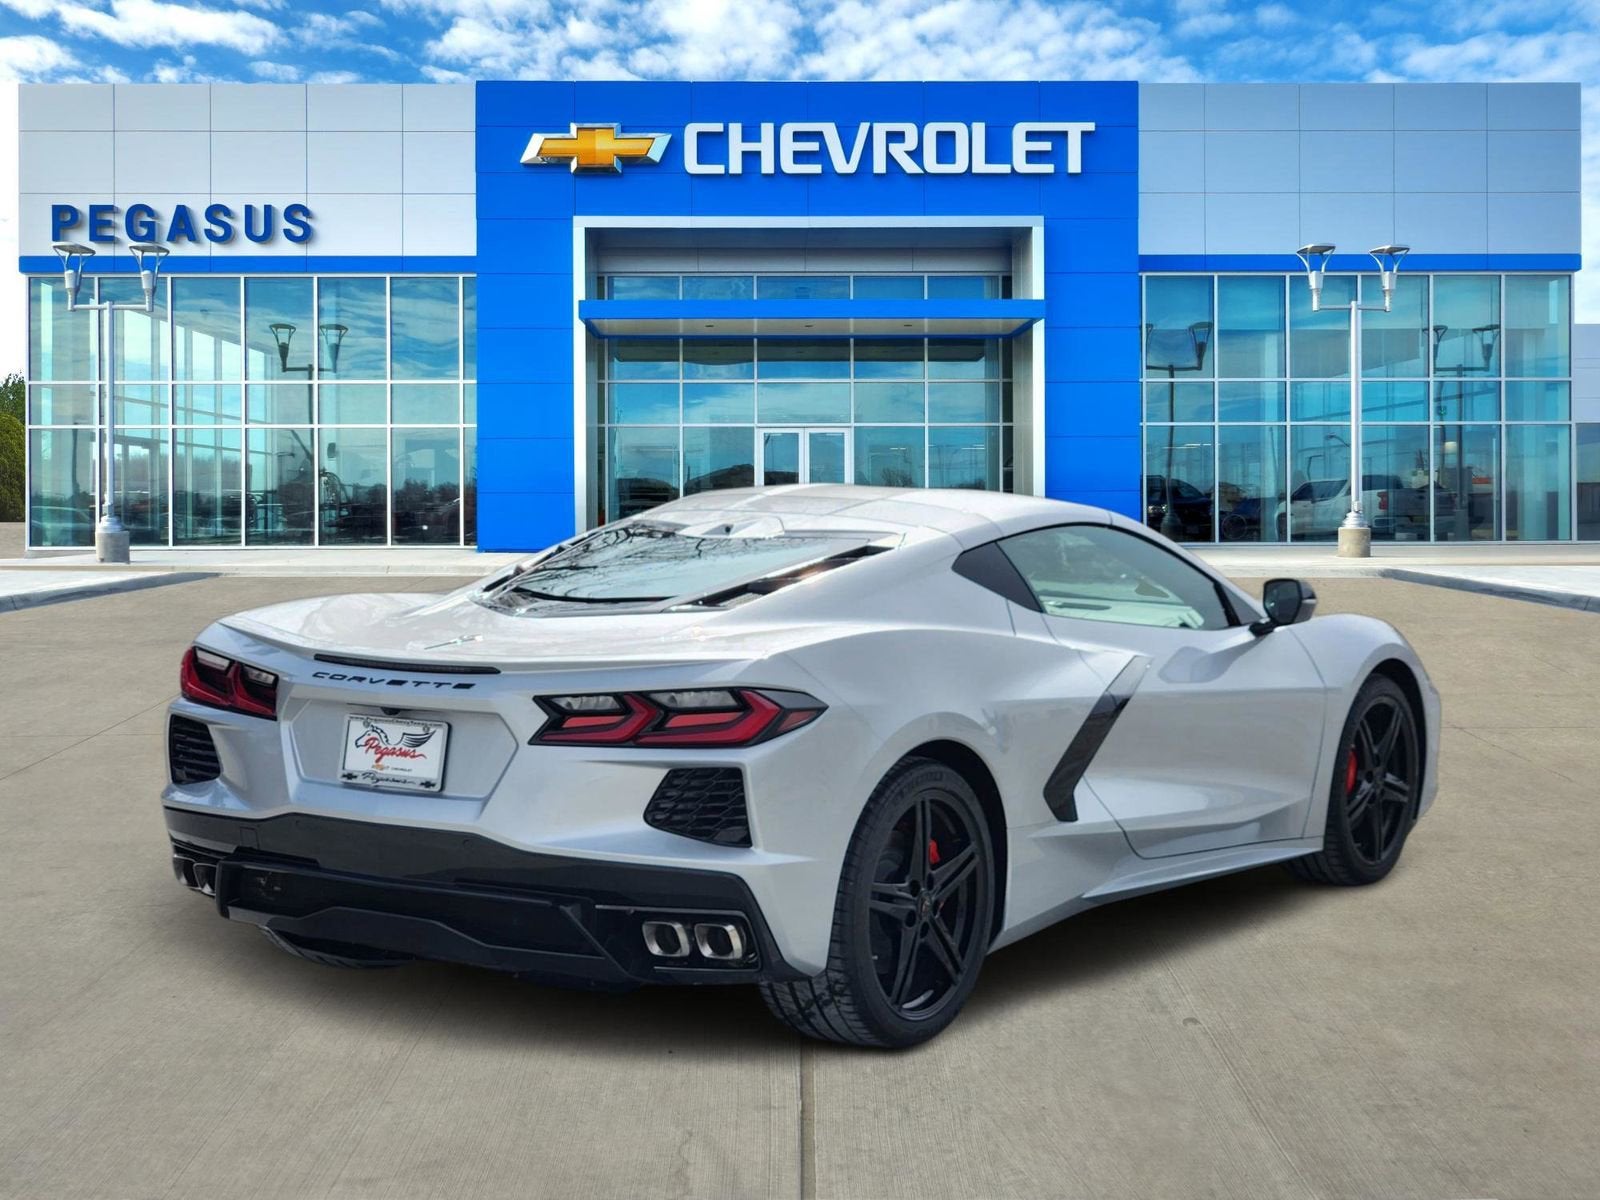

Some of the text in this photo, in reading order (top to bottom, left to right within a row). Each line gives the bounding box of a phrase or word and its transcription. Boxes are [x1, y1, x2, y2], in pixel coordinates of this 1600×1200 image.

[683, 122, 1096, 175] CHEVROLET
[51, 203, 313, 244] PEGASUS
[312, 671, 477, 690] CORVETTE
[364, 736, 427, 764] Pegasus
